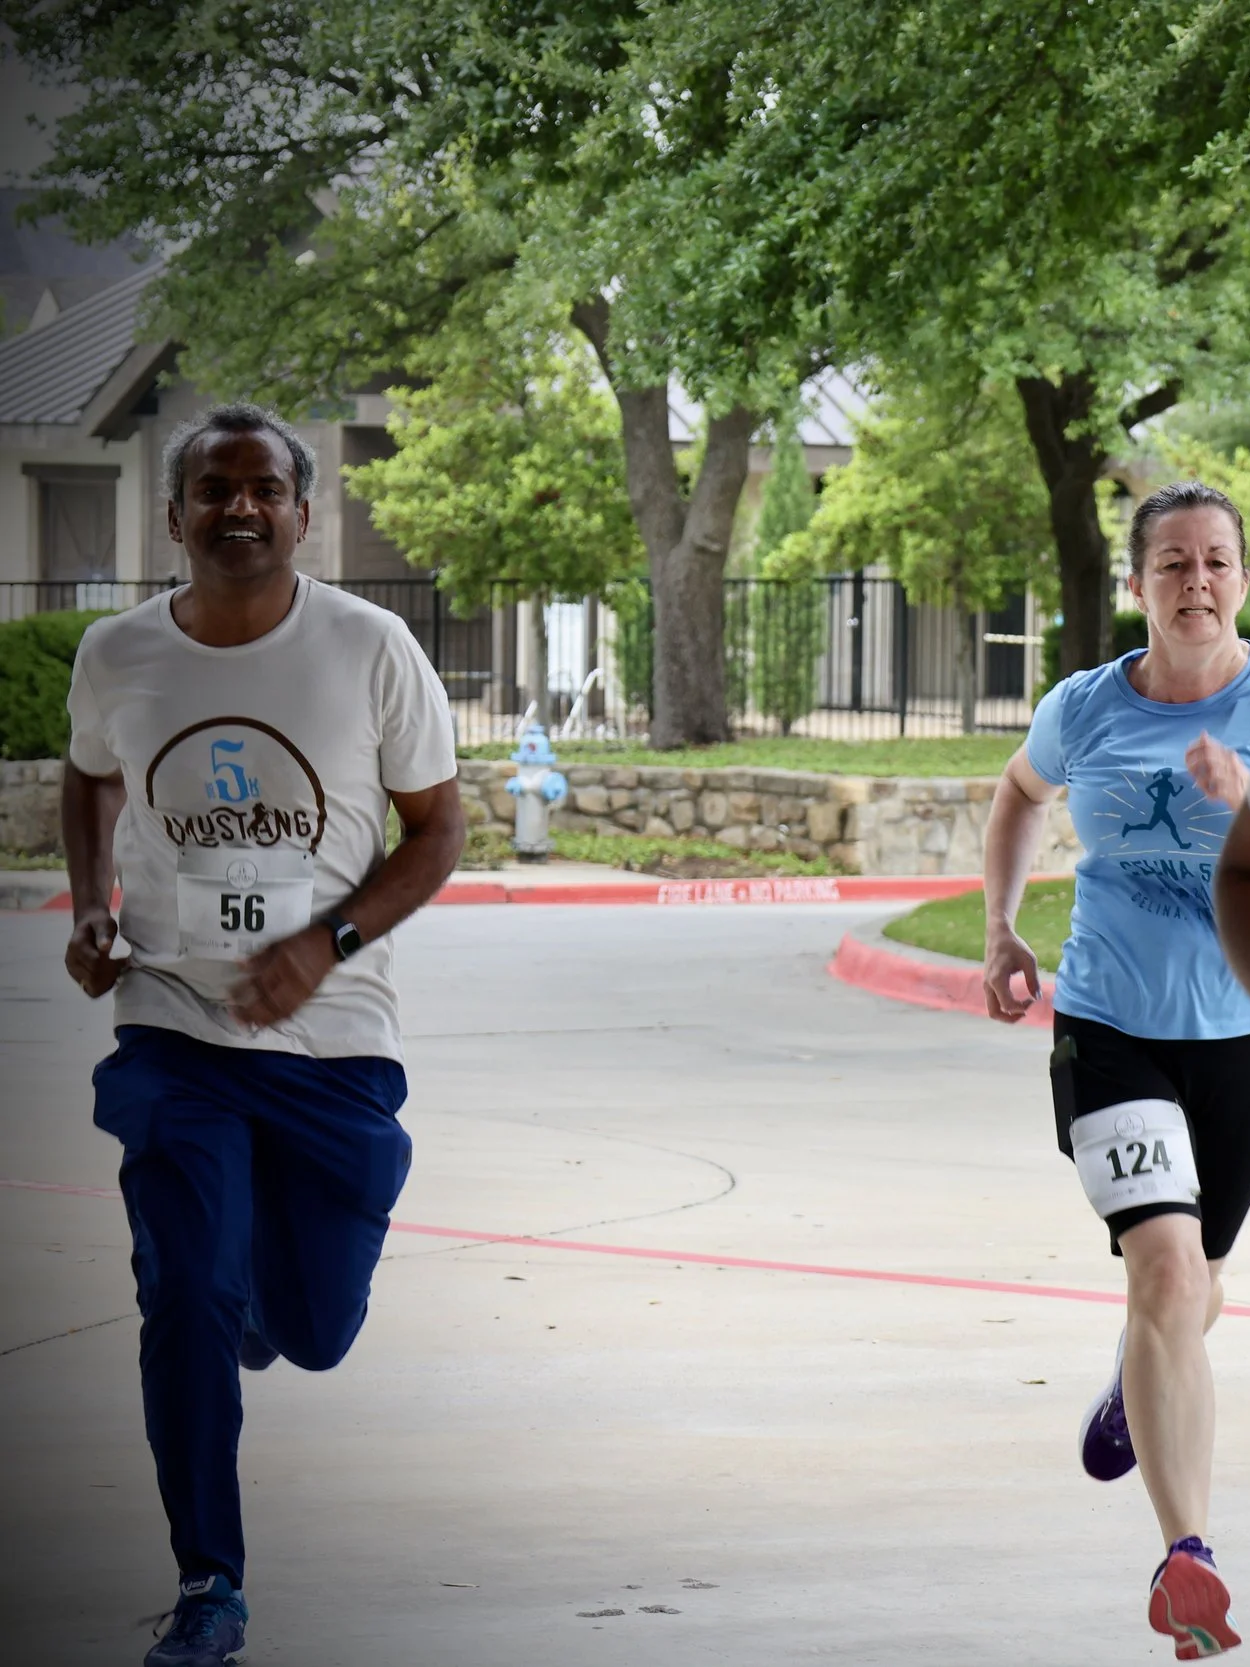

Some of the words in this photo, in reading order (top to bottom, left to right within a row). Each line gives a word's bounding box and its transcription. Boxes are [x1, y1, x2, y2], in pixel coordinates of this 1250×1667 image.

[163, 801, 312, 848] MUSTANG
[220, 893, 265, 933] 56
[1105, 1138, 1172, 1183] 124
